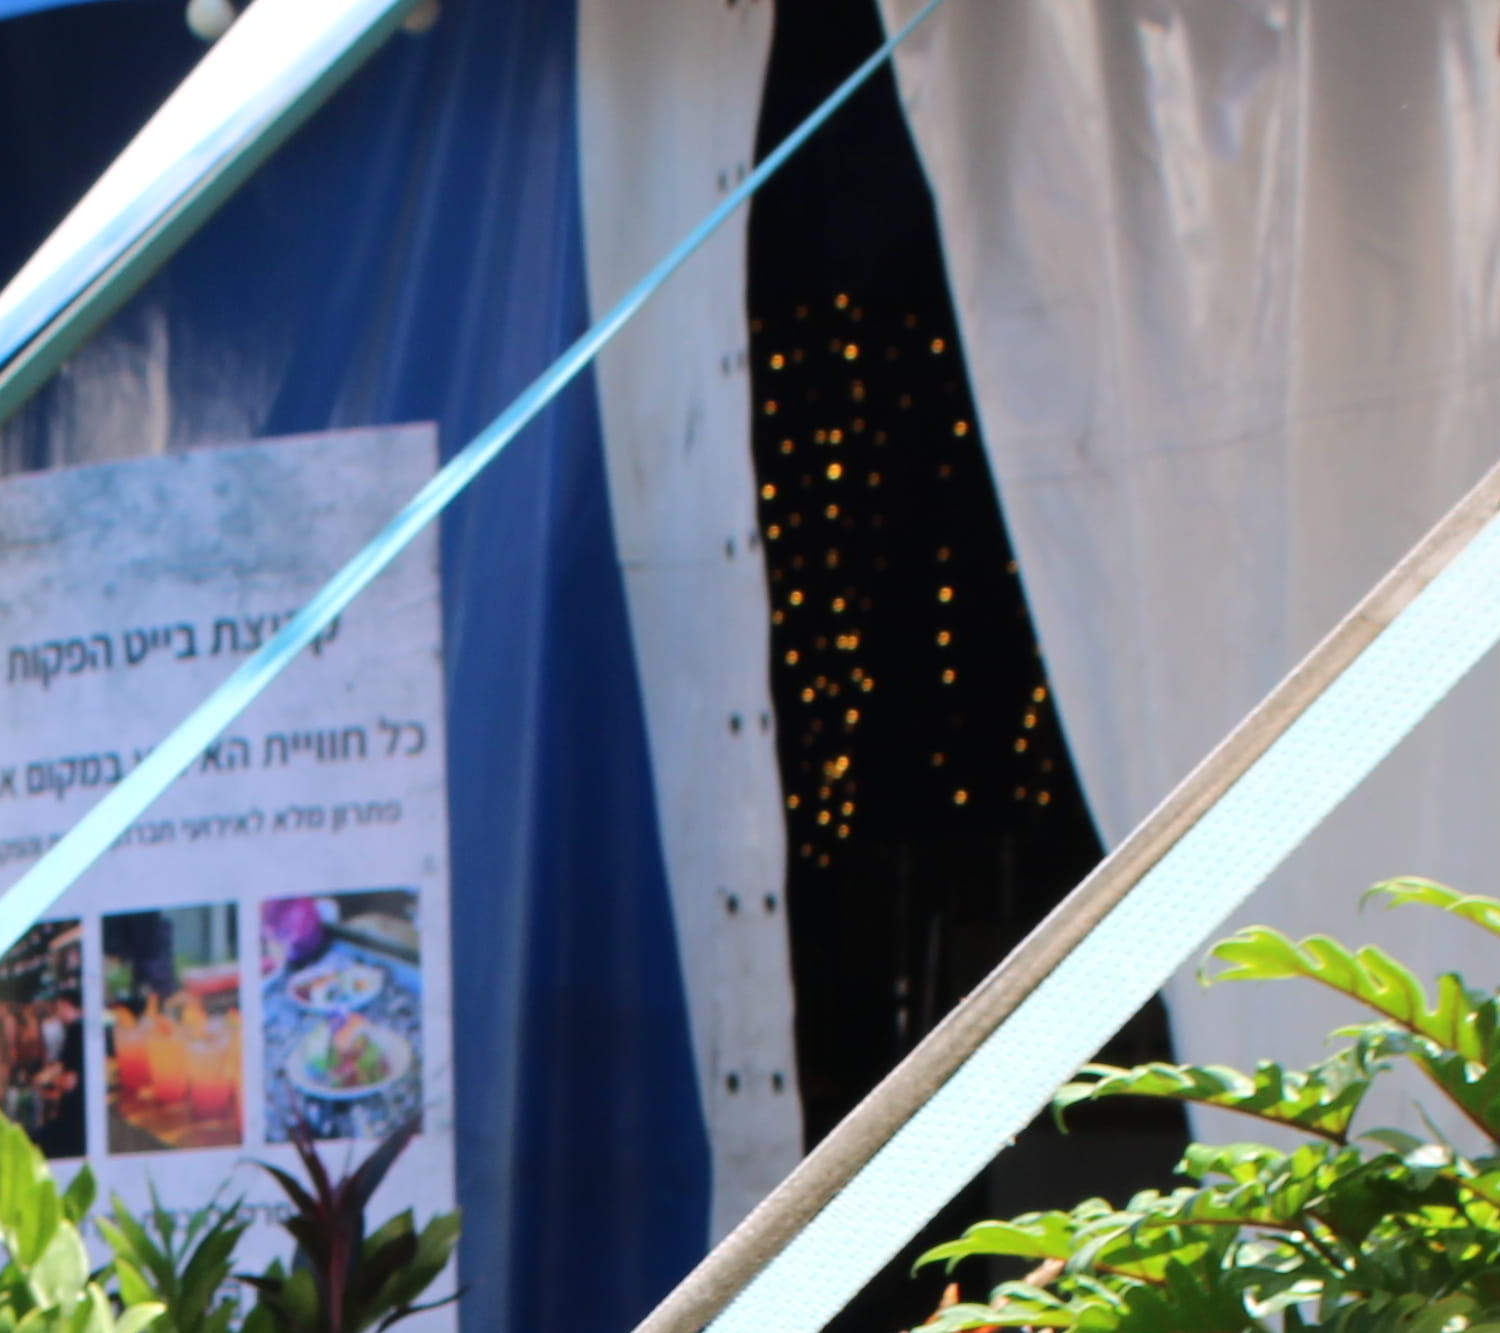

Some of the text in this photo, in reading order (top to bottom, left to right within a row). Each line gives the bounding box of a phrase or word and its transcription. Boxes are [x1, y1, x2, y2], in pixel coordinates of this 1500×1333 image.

[6, 633, 113, 690] הפקות
[123, 620, 197, 665] בייט
[262, 726, 366, 769] חוויית
[378, 716, 427, 757] כל
[24, 750, 123, 801] במקום
[271, 803, 325, 834] מלא
